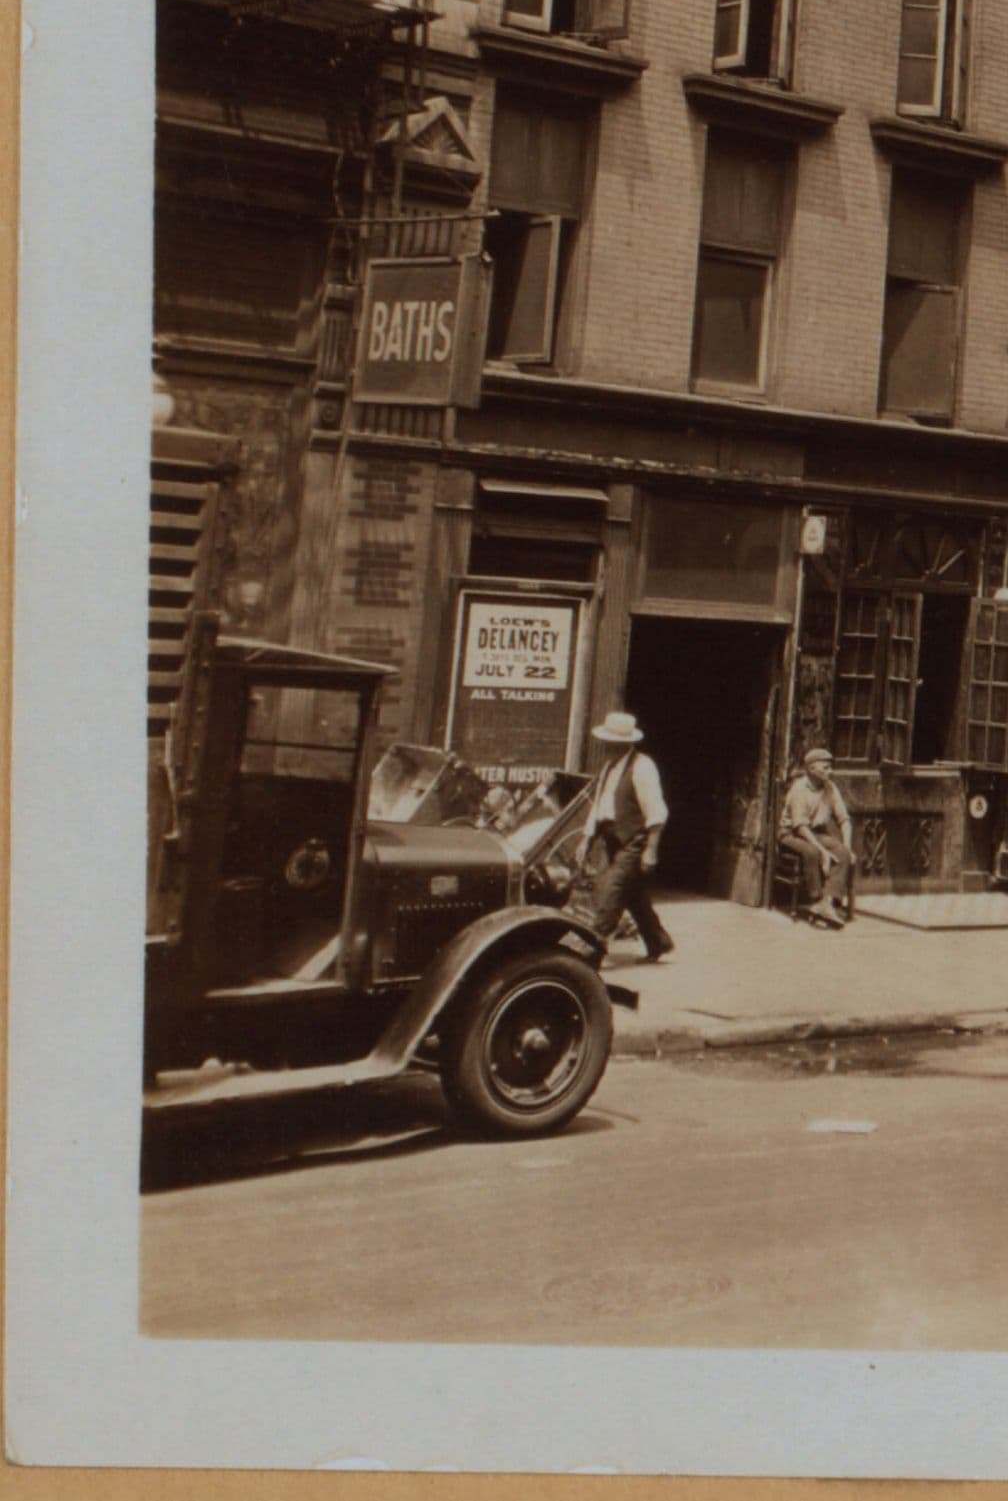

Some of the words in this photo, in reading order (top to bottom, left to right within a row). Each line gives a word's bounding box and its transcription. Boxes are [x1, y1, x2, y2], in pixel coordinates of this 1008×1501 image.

[367, 301, 455, 362] BATHS
[489, 617, 551, 628] LOEW'S
[477, 627, 560, 653] DELANCEY
[474, 663, 515, 677] JULY
[523, 665, 557, 680] 22
[470, 689, 497, 701] ALL
[500, 689, 556, 703] TALKING
